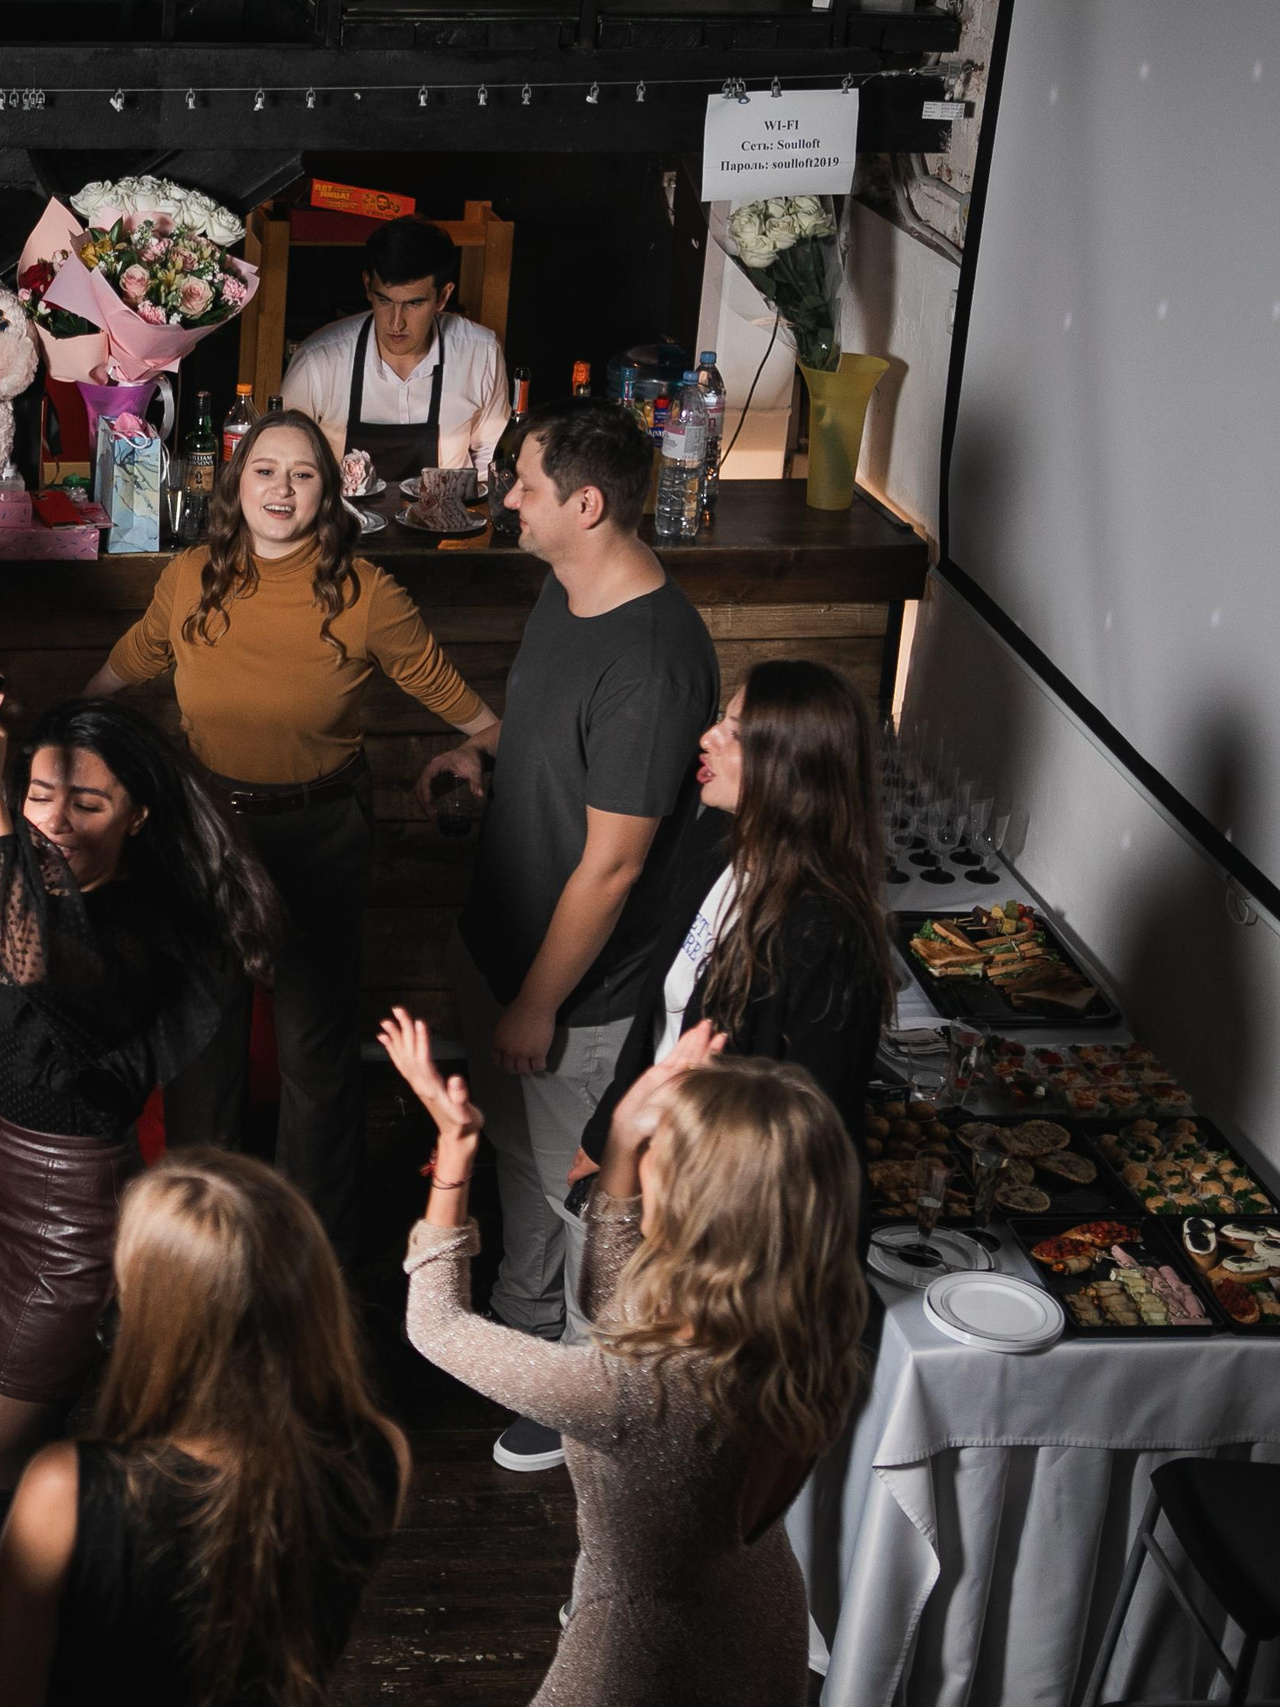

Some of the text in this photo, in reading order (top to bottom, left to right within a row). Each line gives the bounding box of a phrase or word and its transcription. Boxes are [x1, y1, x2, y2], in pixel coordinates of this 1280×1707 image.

[764, 120, 800, 131] WI-FI
[741, 138, 821, 151] Сеть: Soulloft
[720, 157, 840, 173] Пароль: soulloft2019
